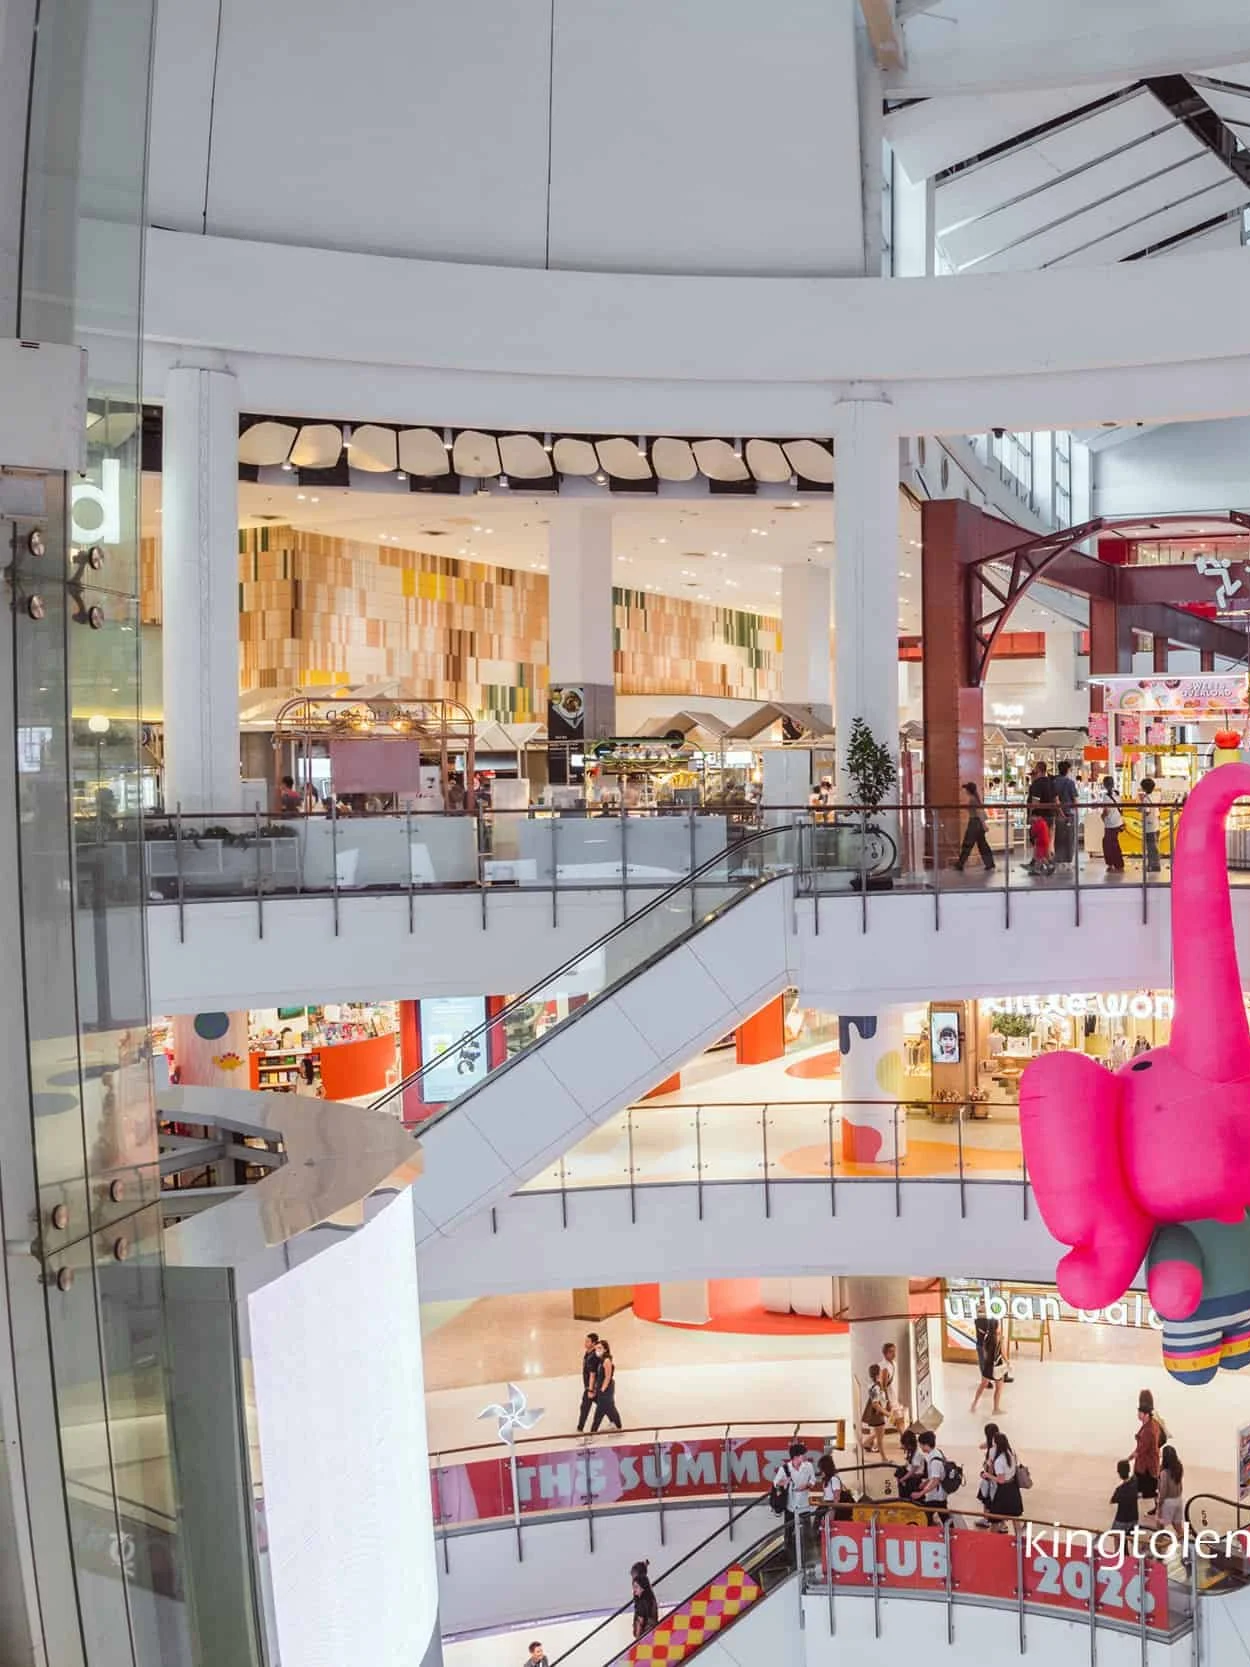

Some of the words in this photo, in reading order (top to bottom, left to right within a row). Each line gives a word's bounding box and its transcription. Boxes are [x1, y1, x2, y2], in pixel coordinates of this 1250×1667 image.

[945, 1286, 1060, 1320] urban
[517, 1453, 608, 1500] THE
[830, 1535, 948, 1578] CLUB
[1034, 1556, 1155, 1613] 2026
